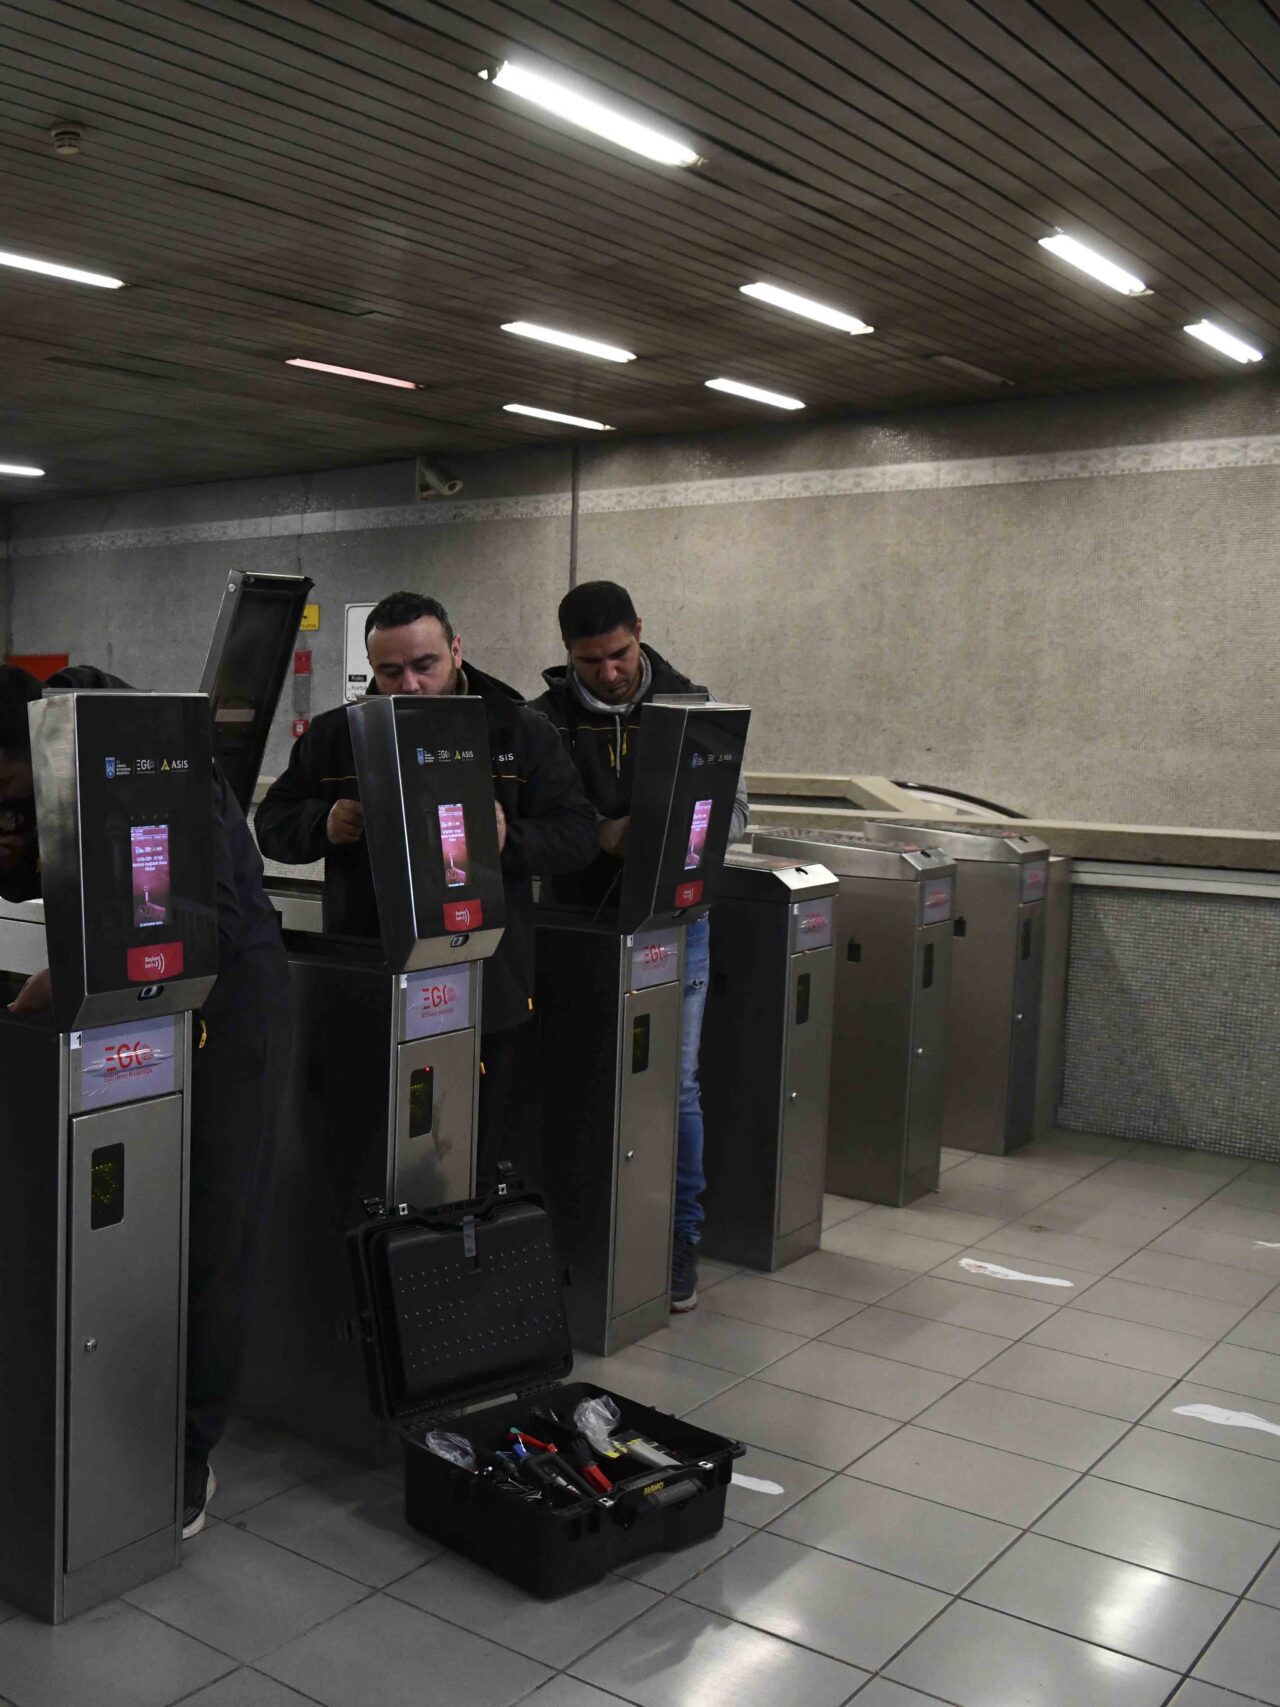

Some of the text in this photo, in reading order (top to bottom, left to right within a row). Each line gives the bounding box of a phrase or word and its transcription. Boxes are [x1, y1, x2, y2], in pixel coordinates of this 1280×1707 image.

[493, 752, 514, 762] SIS
[136, 759, 155, 771] EGO
[171, 759, 189, 769] ASIS
[105, 1041, 153, 1072] EGO
